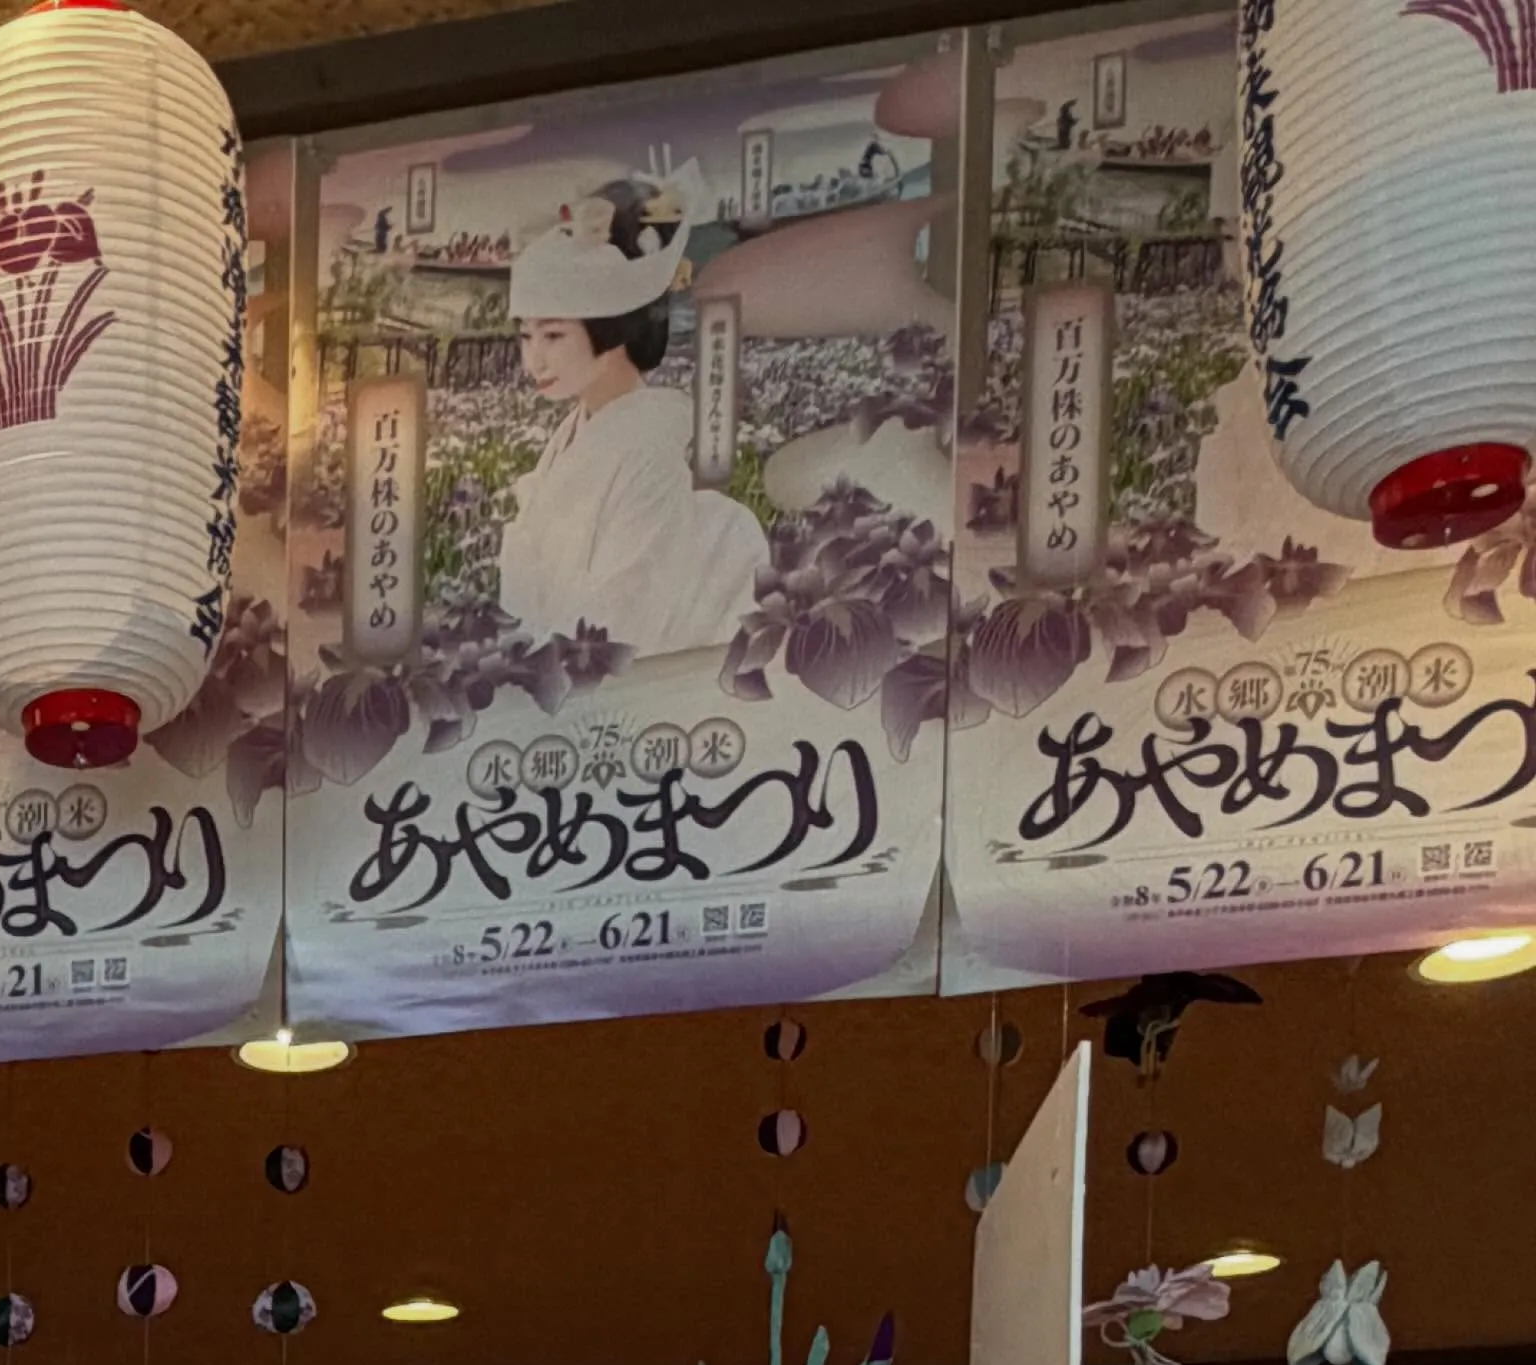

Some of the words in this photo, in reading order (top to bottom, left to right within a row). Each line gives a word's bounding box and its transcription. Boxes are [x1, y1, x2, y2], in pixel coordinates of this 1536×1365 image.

[370, 410, 400, 629] 百万株のあやめ
[1047, 318, 1083, 551] 百万株のあやめ
[349, 739, 878, 914] あやめまつり
